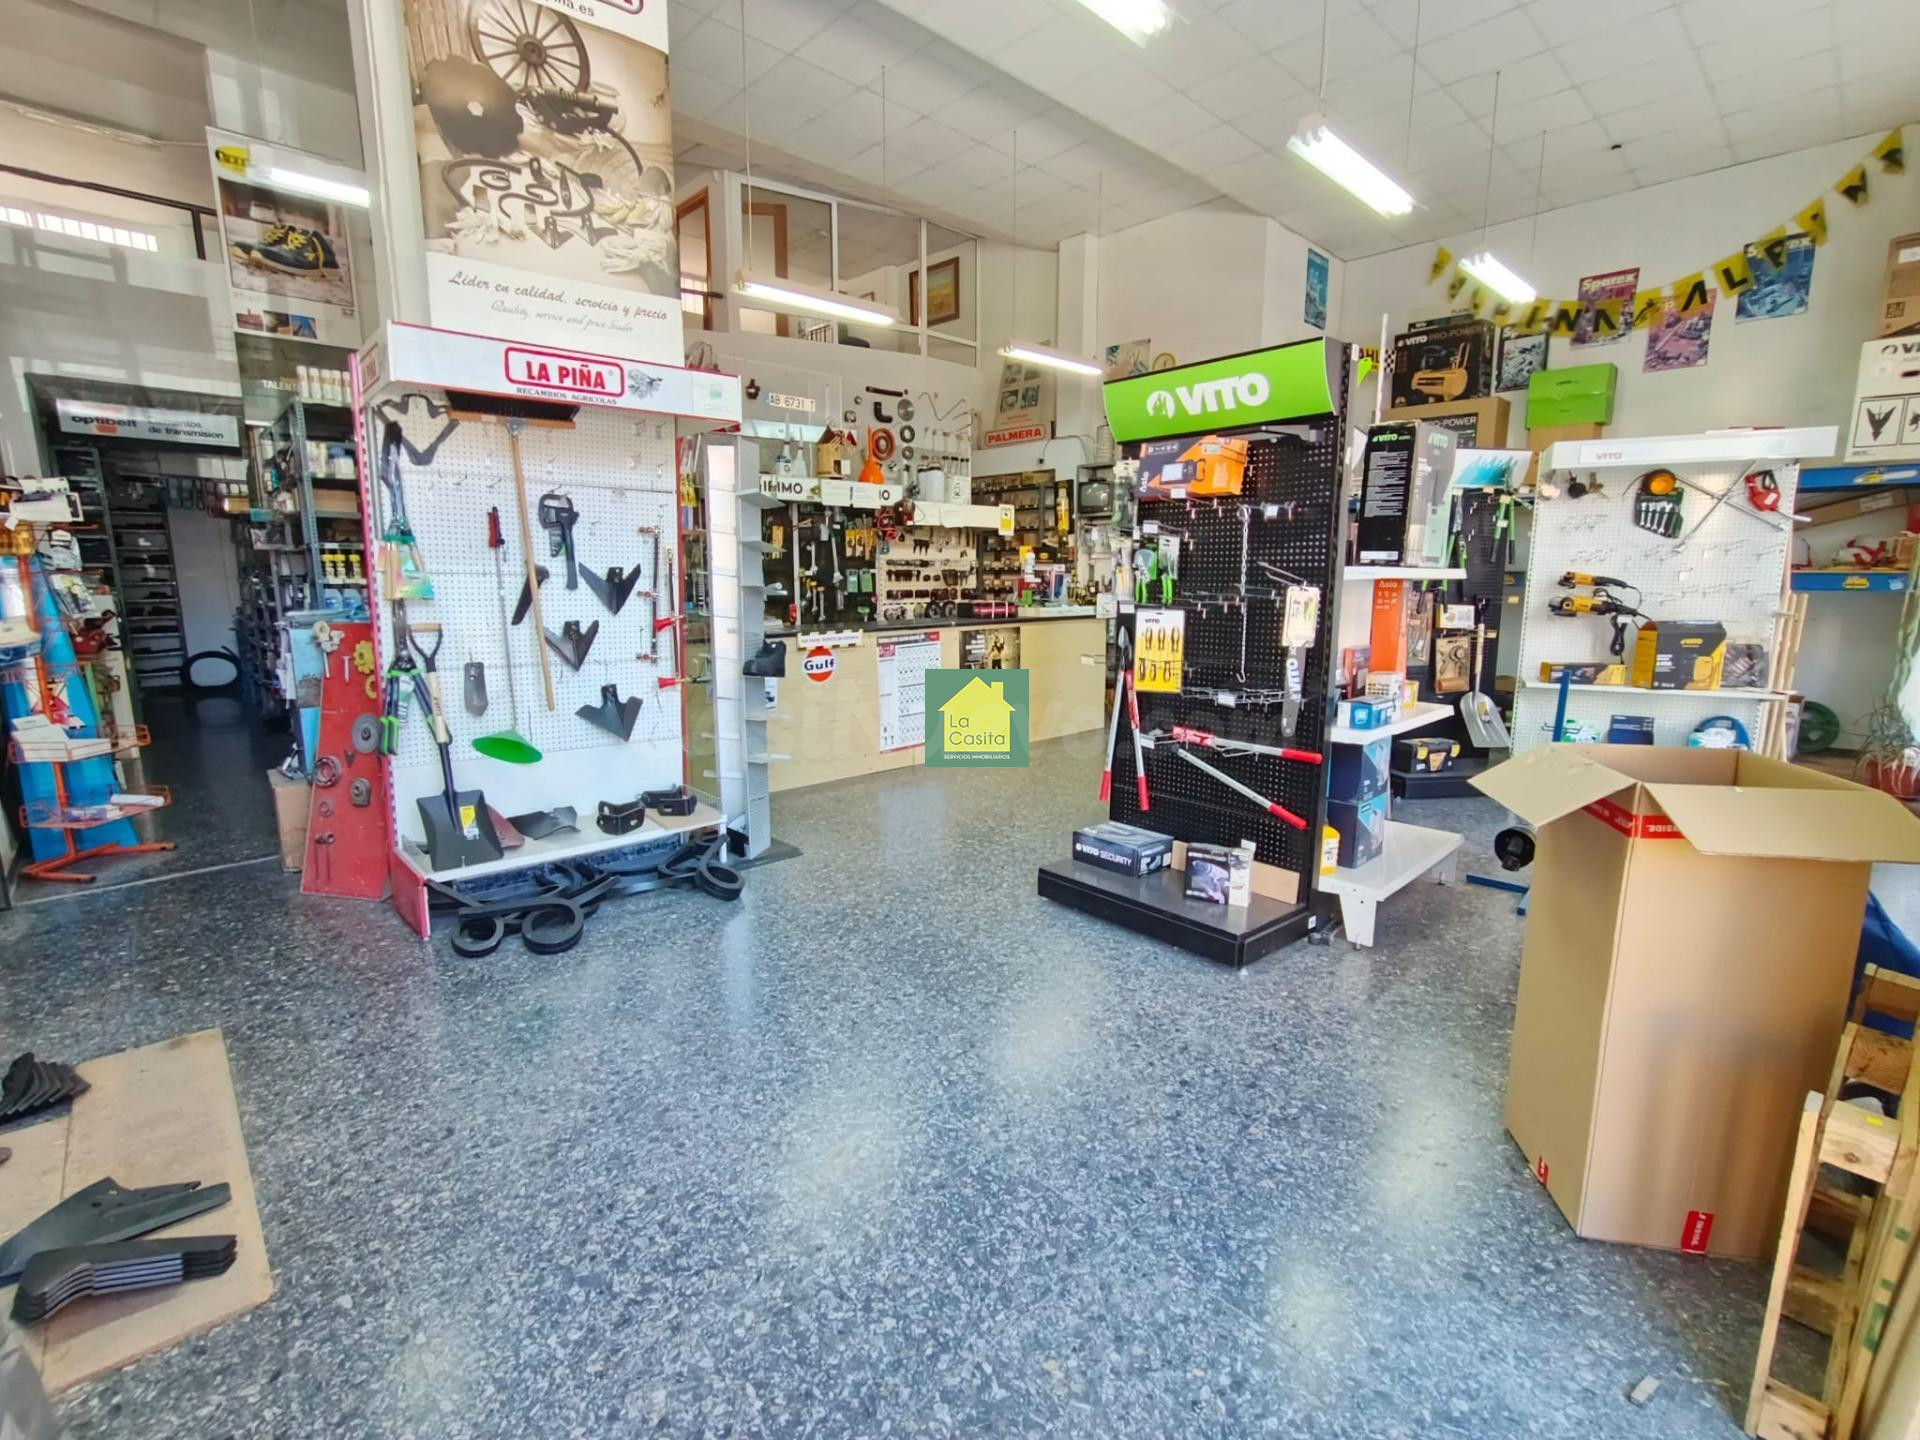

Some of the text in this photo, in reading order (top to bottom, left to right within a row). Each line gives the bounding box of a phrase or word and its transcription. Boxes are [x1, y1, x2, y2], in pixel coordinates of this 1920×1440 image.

[1581, 272, 1637, 290] Sparex
[495, 283, 509, 293] en
[515, 285, 568, 304] calidad,
[575, 297, 618, 312] servicio
[622, 304, 631, 317] y
[634, 306, 668, 321] precio
[536, 311, 563, 322] service
[567, 313, 584, 325] and
[1405, 335, 1428, 346] VITO
[526, 360, 606, 389] LA PIÑA
[516, 387, 617, 405] RECAMBIOS AGRICOLAS
[1176, 372, 1270, 416] VITO
[785, 397, 805, 409] 6731
[71, 415, 138, 428] optibelt
[1430, 415, 1477, 427] O-POWER
[148, 426, 161, 435] de
[988, 428, 1041, 443] PALMERA
[1379, 433, 1398, 442] VITO
[1596, 452, 1622, 460] VITO
[804, 659, 835, 671] Gulf
[1286, 658, 1302, 691] VITO
[1082, 844, 1100, 857] VITO
[1100, 850, 1133, 866] SECURITY
